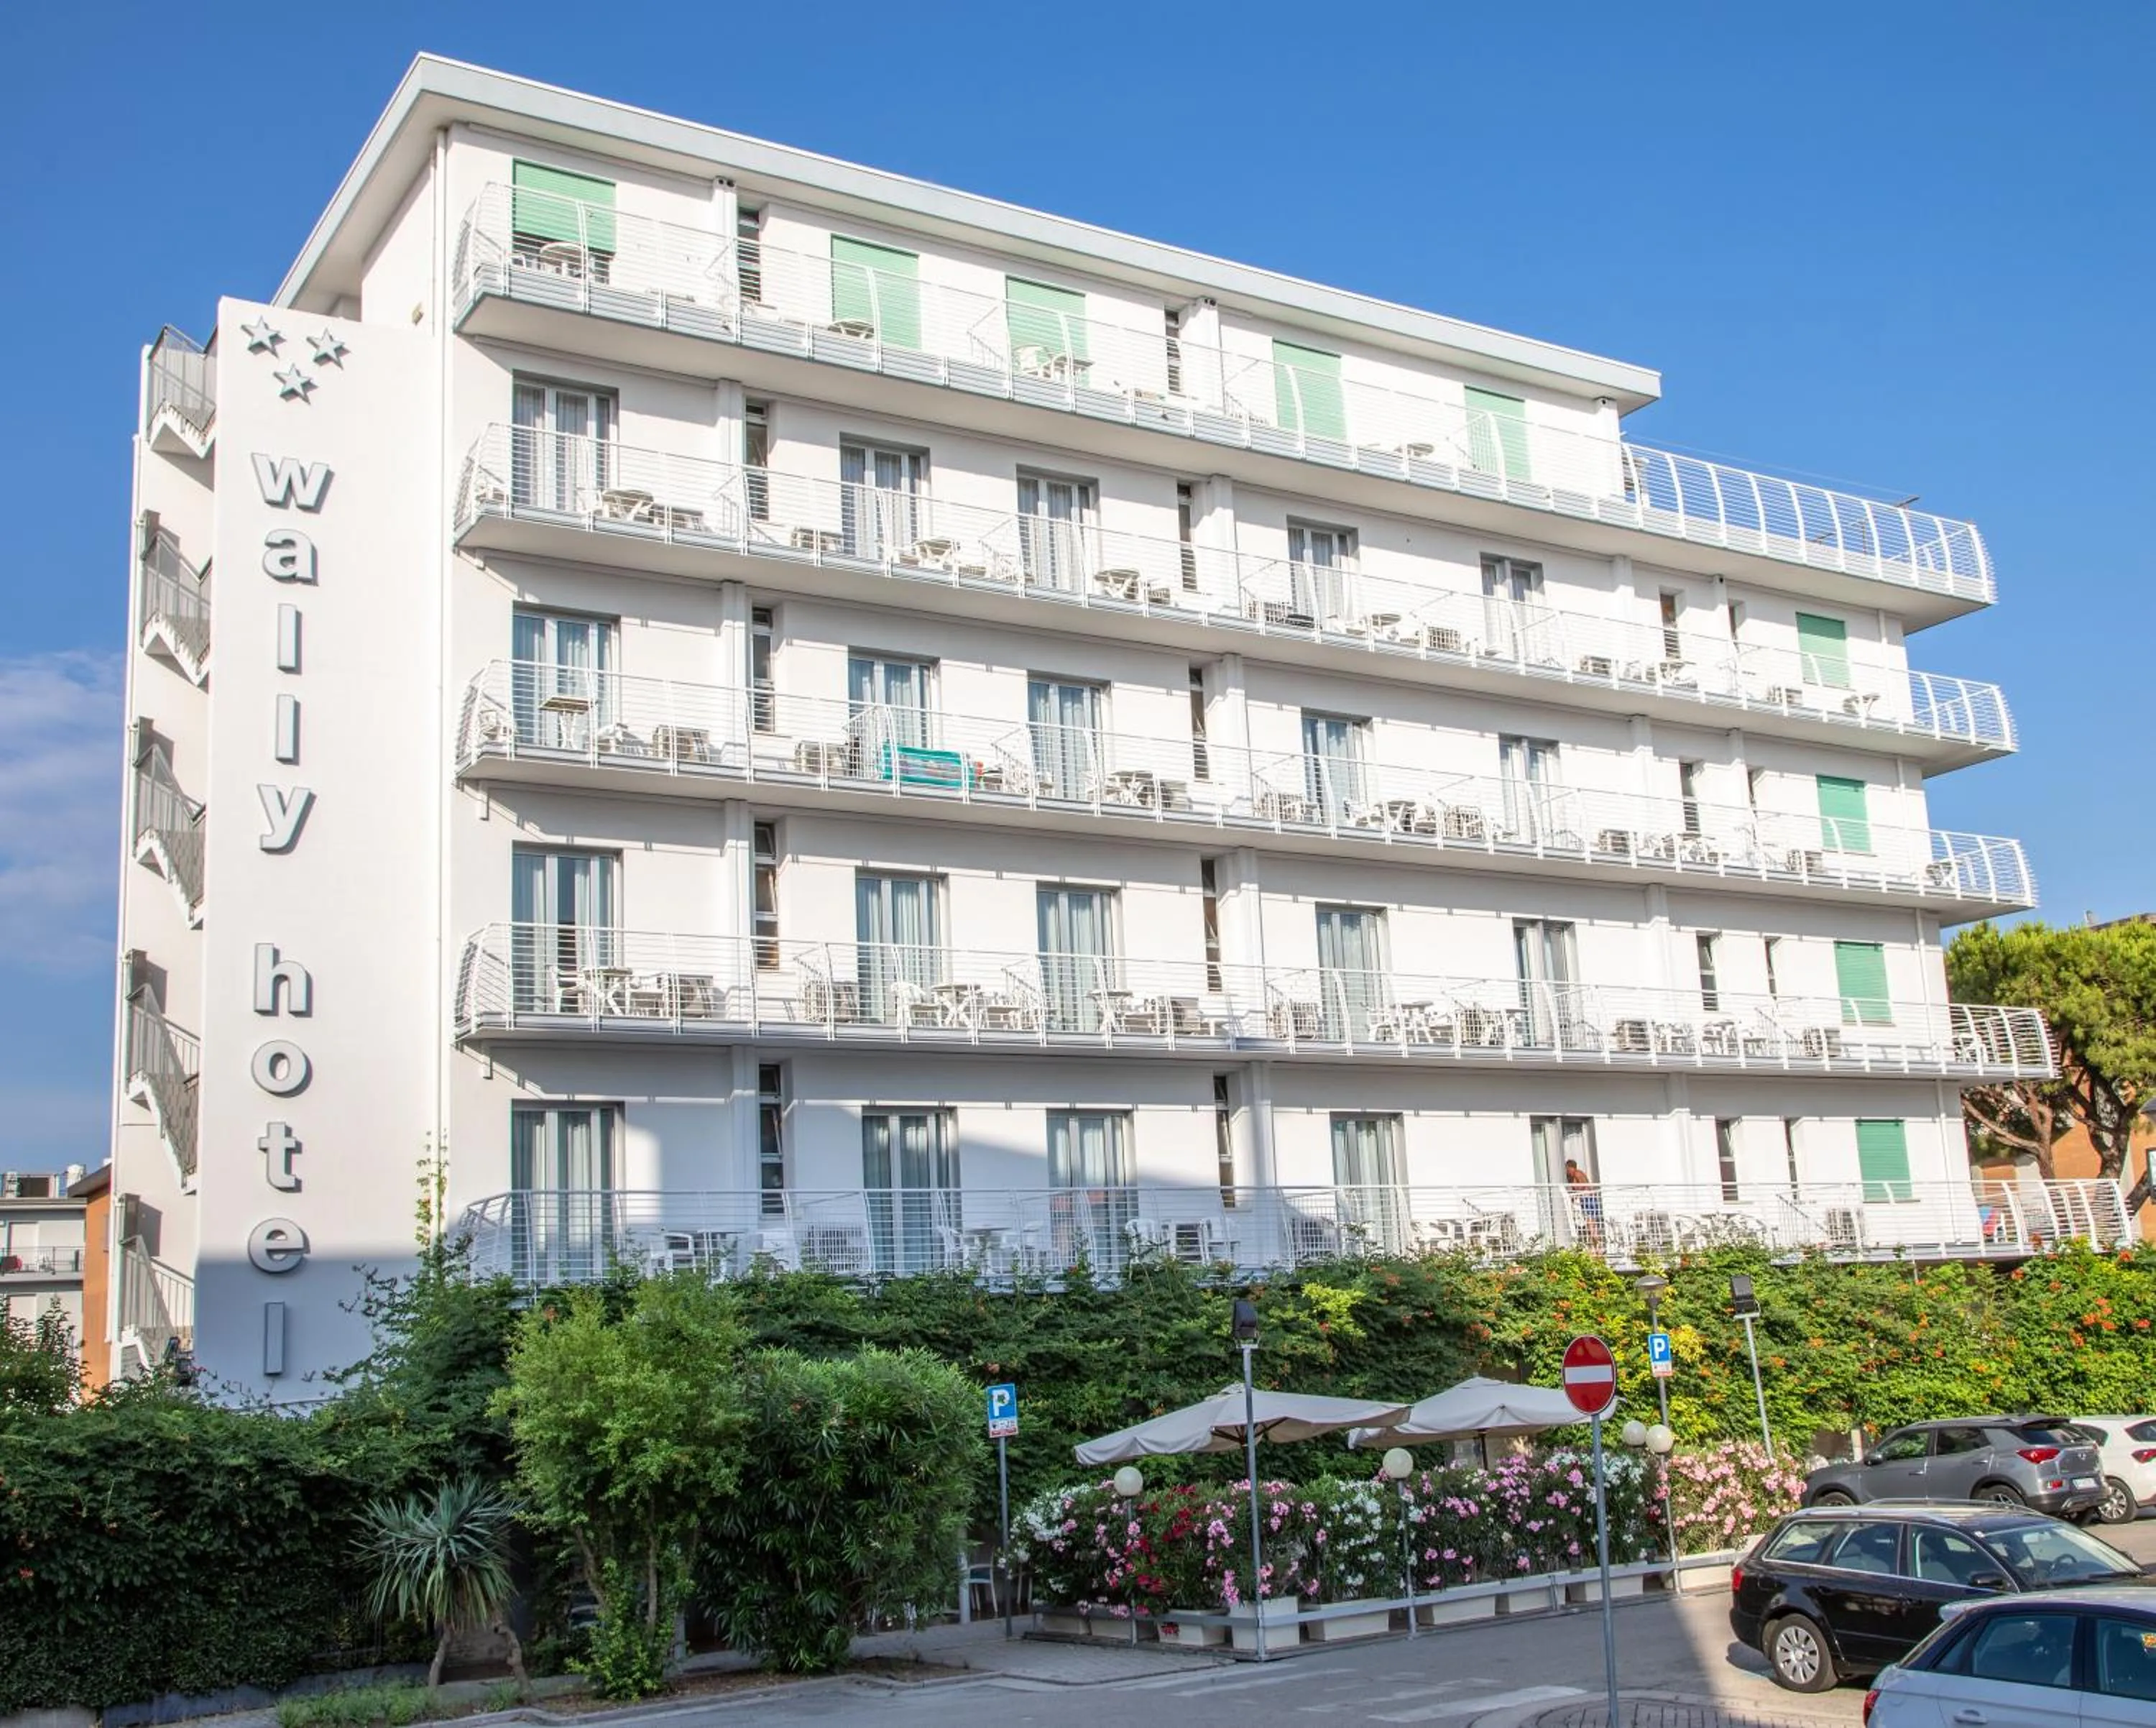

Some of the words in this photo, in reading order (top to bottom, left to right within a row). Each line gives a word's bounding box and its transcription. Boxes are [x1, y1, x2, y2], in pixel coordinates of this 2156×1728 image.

[251, 452, 331, 852] wally
[248, 942, 309, 1376] hotel
[992, 1389, 1010, 1417] P
[1654, 1338, 1665, 1359] P
